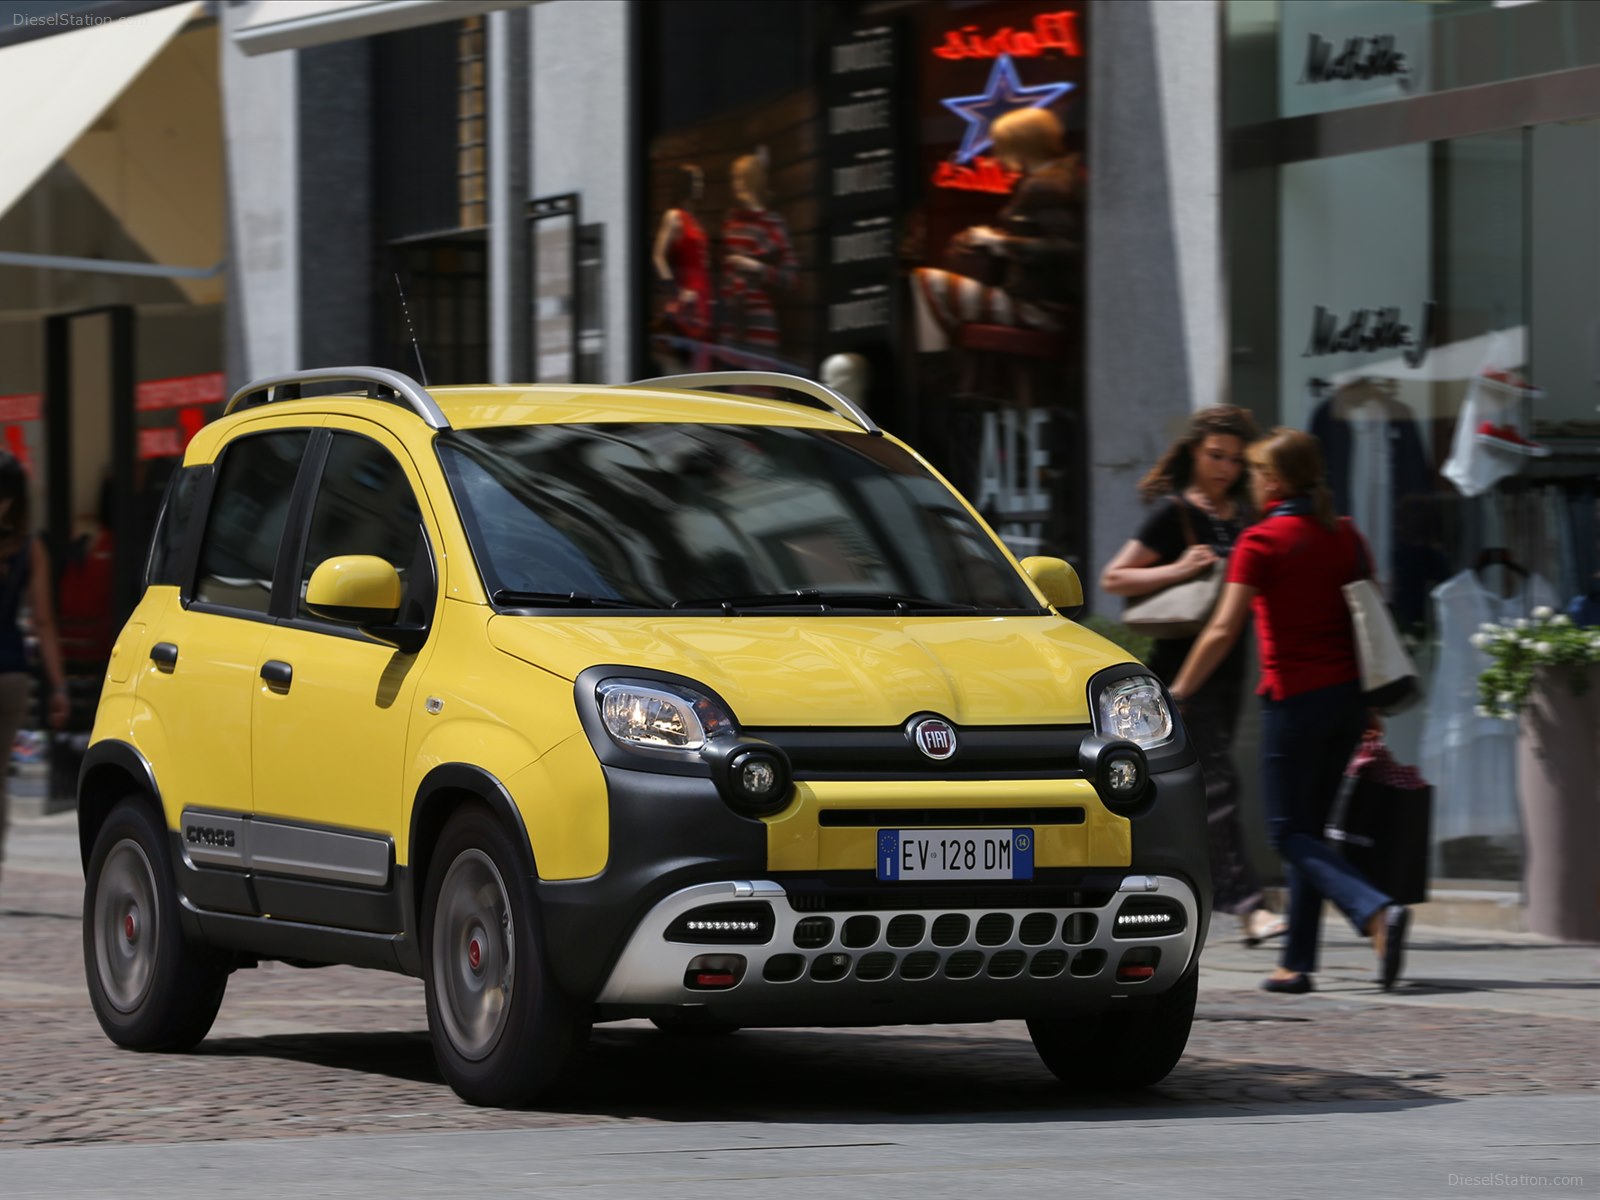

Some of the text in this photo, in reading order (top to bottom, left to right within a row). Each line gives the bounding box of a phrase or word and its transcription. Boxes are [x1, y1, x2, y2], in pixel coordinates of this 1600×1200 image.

[924, 730, 949, 749] FIAT
[902, 839, 1011, 871] EV 128 DM
